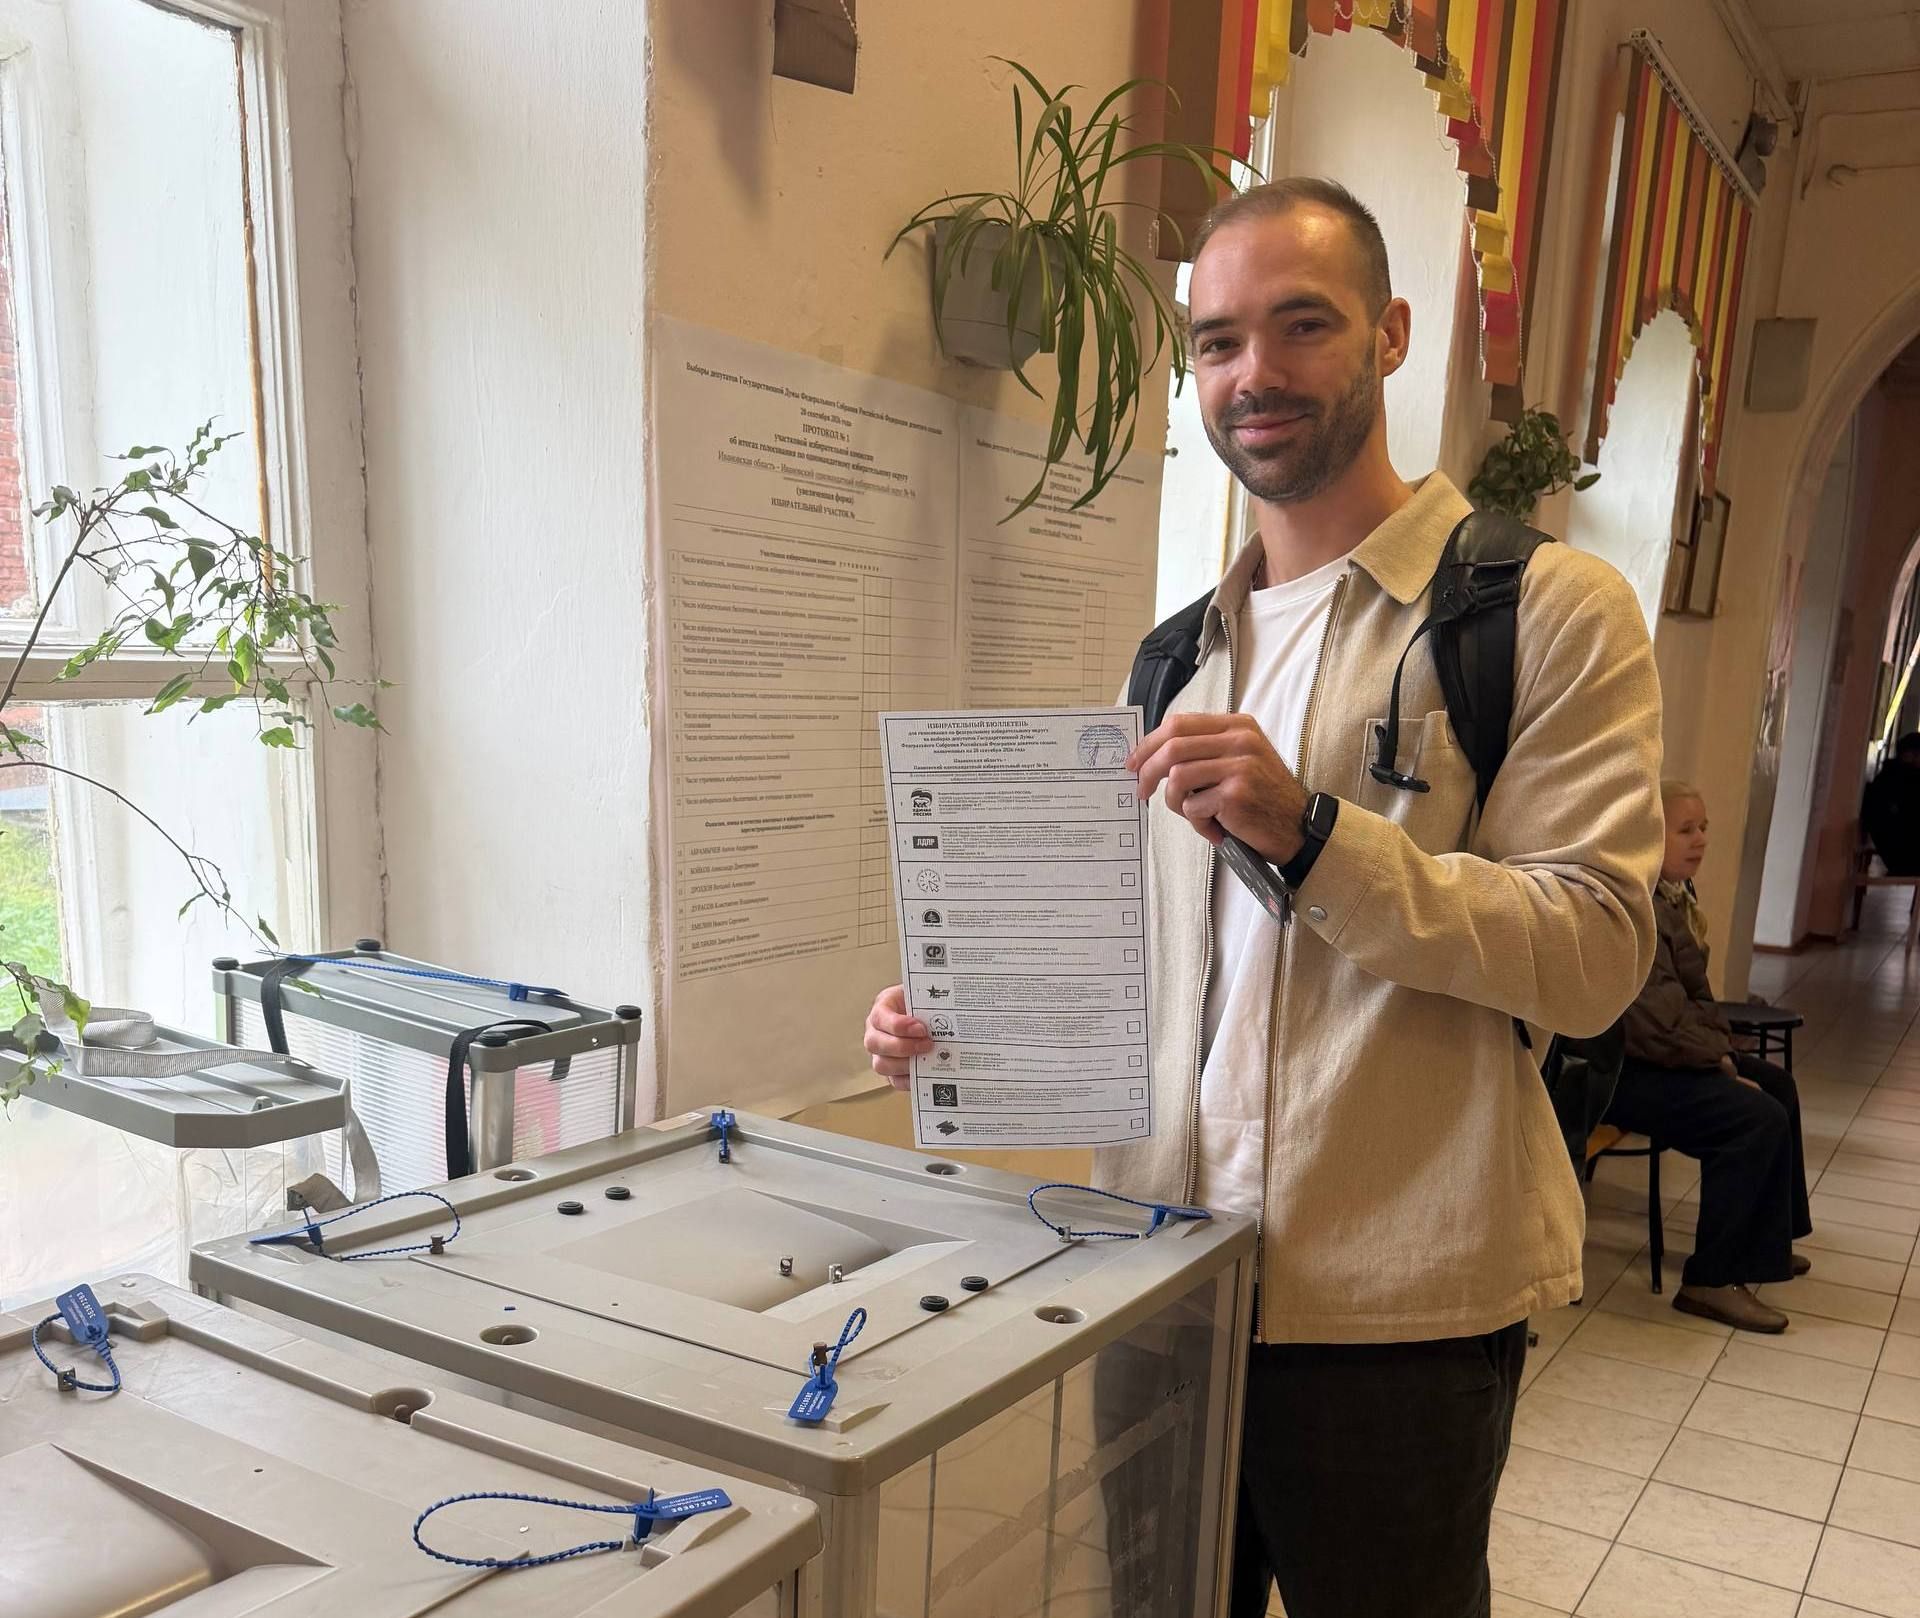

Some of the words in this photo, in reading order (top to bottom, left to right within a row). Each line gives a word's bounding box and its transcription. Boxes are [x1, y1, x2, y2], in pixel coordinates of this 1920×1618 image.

[802, 423, 839, 440] ПРОТОКОЛ
[927, 721, 985, 729] ИЗБИРАТЕЛЬНЫЙ
[986, 720, 1028, 728] БЮЛЛЕТЕНЬ
[917, 838, 935, 847] ЛДПР
